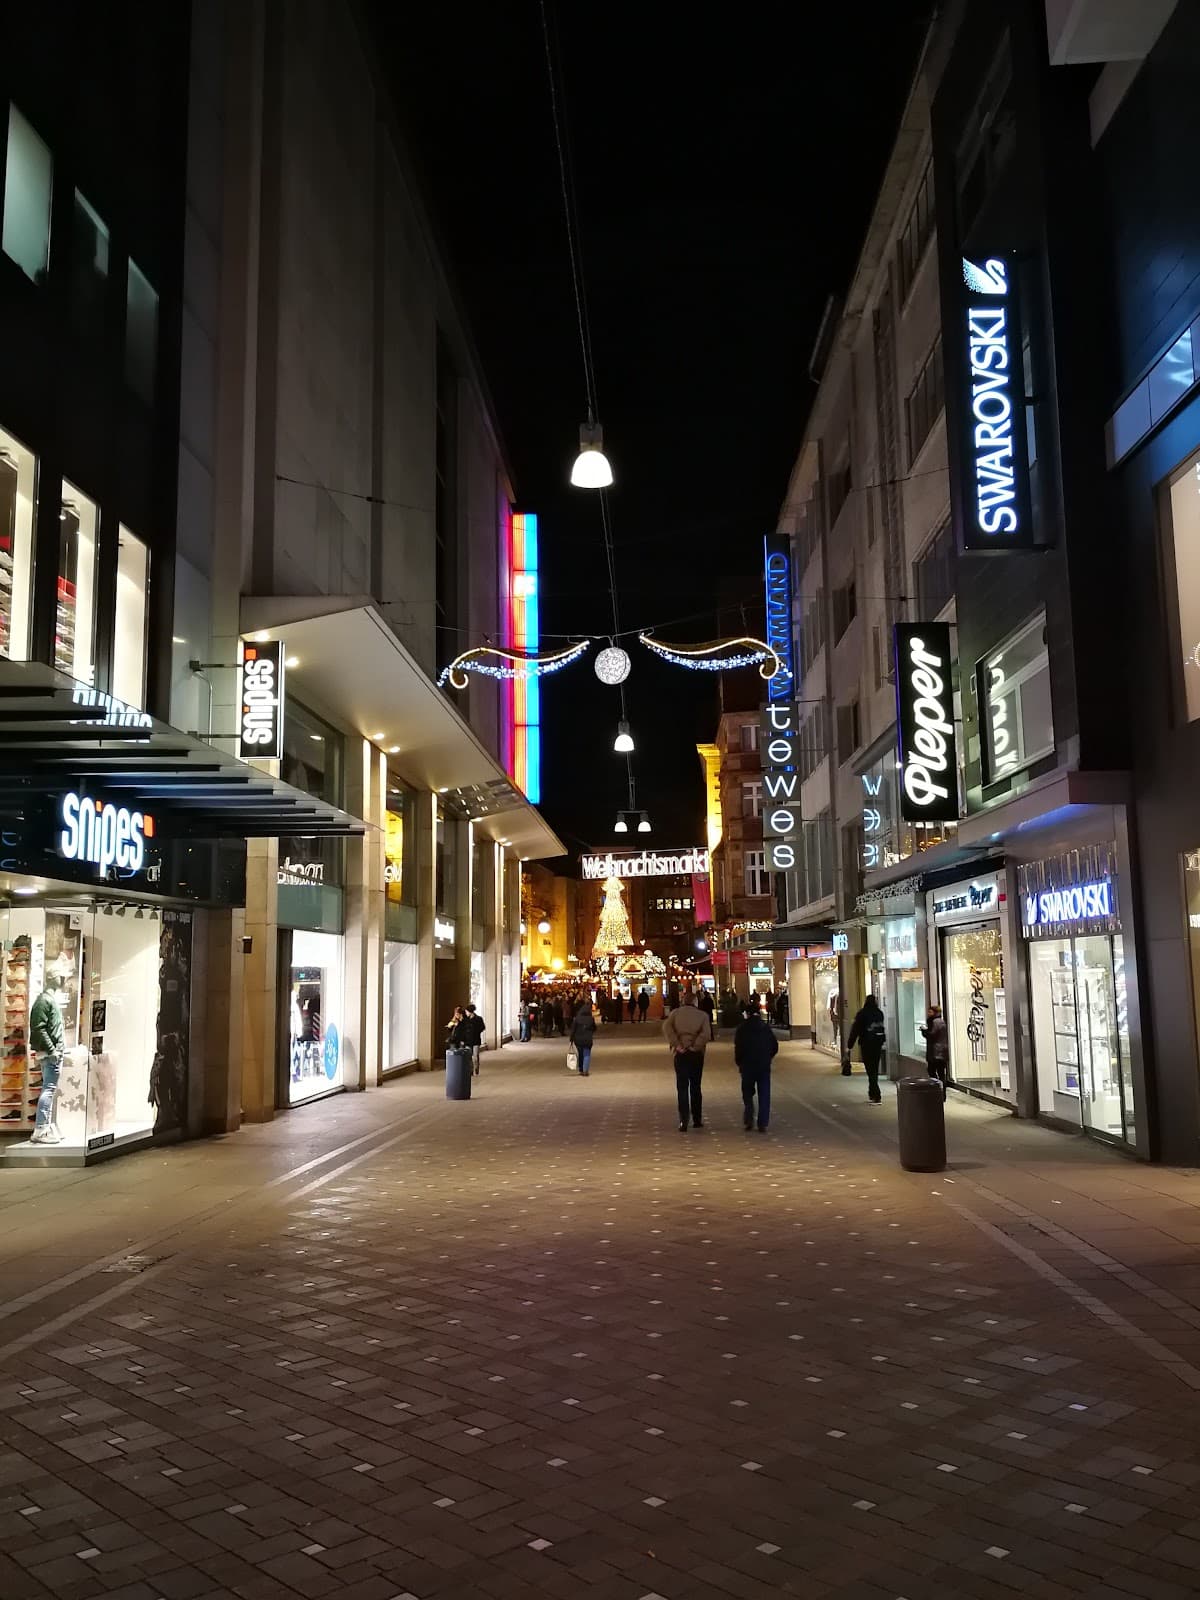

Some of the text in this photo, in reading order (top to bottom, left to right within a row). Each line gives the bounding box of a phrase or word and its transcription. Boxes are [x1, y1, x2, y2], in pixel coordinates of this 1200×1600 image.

[968, 307, 1018, 534] SWAROVSKI
[242, 658, 274, 745] snipes
[764, 703, 797, 869] tewes
[61, 791, 144, 877] snipes
[582, 847, 710, 879] Weihnachtsmarkt
[1039, 882, 1110, 924] SWAROVSKI
